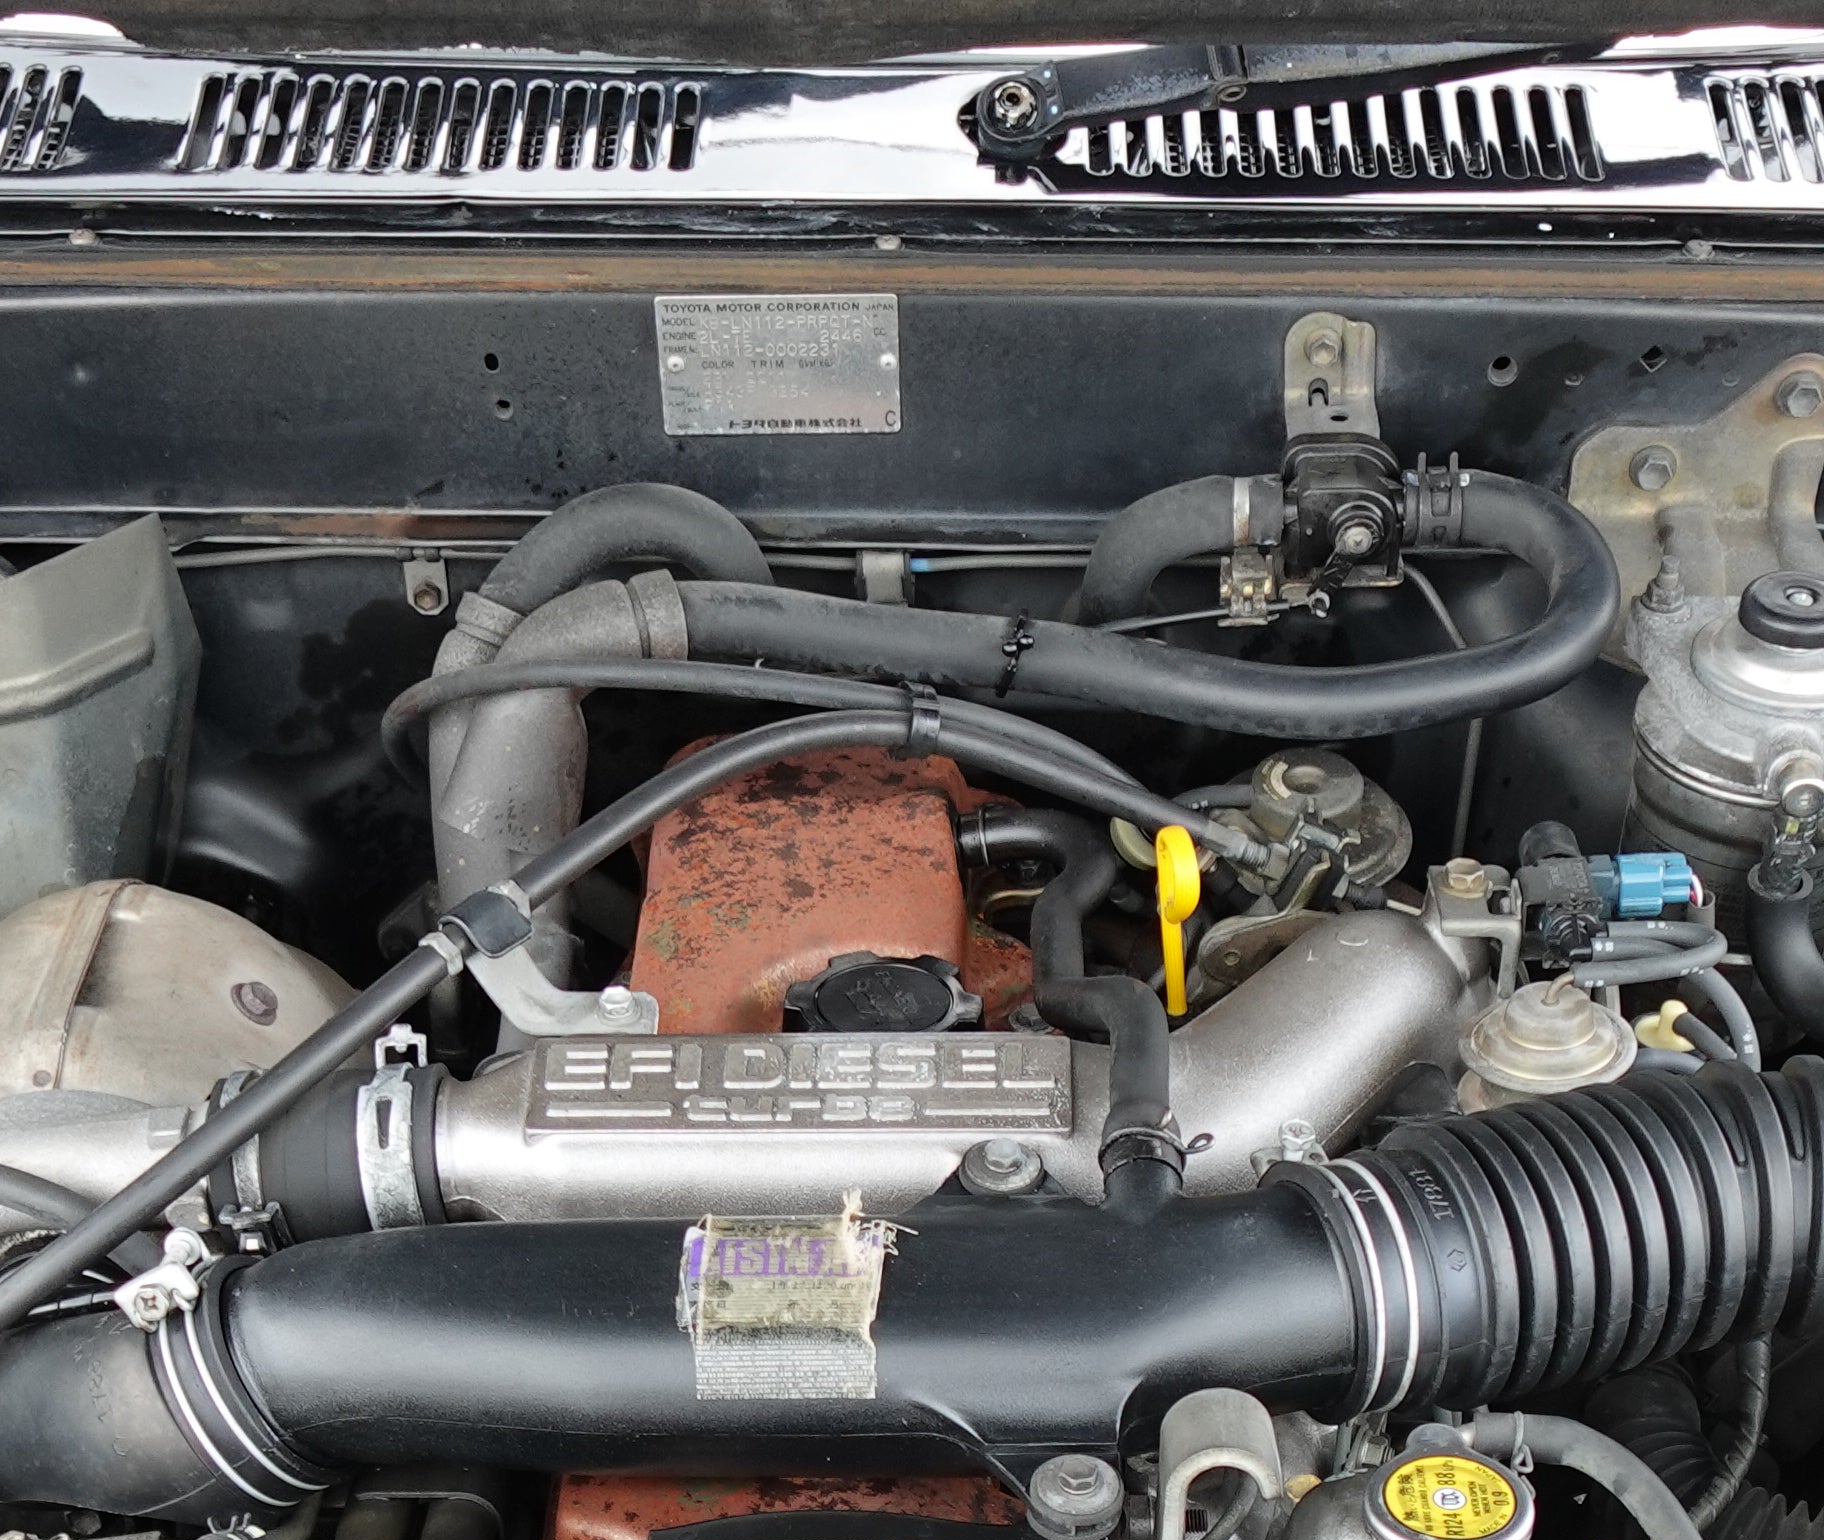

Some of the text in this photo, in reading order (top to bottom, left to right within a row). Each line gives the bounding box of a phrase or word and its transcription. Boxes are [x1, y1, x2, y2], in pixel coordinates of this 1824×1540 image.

[664, 302, 894, 313] TOYOTA MOTOR CORPORATION JAPAN
[662, 318, 695, 326] MODEL
[663, 332, 697, 340] ENGINE
[700, 330, 752, 343] 2L-TE
[820, 329, 864, 342] 2446
[702, 360, 734, 369] COLOR
[752, 360, 784, 368] TRIM
[544, 1041, 1056, 1090] EFI DIESEL
[1434, 1472, 1457, 1486] 88
[1475, 1466, 1501, 1482] JAPAN
[1467, 1481, 1481, 1517] NEVER OPEN
[1478, 1483, 1491, 1514] WHEN HOT
[1491, 1491, 1510, 1506] 0.9
[1441, 1512, 1465, 1536] R124
[1478, 1520, 1502, 1534] MADE
